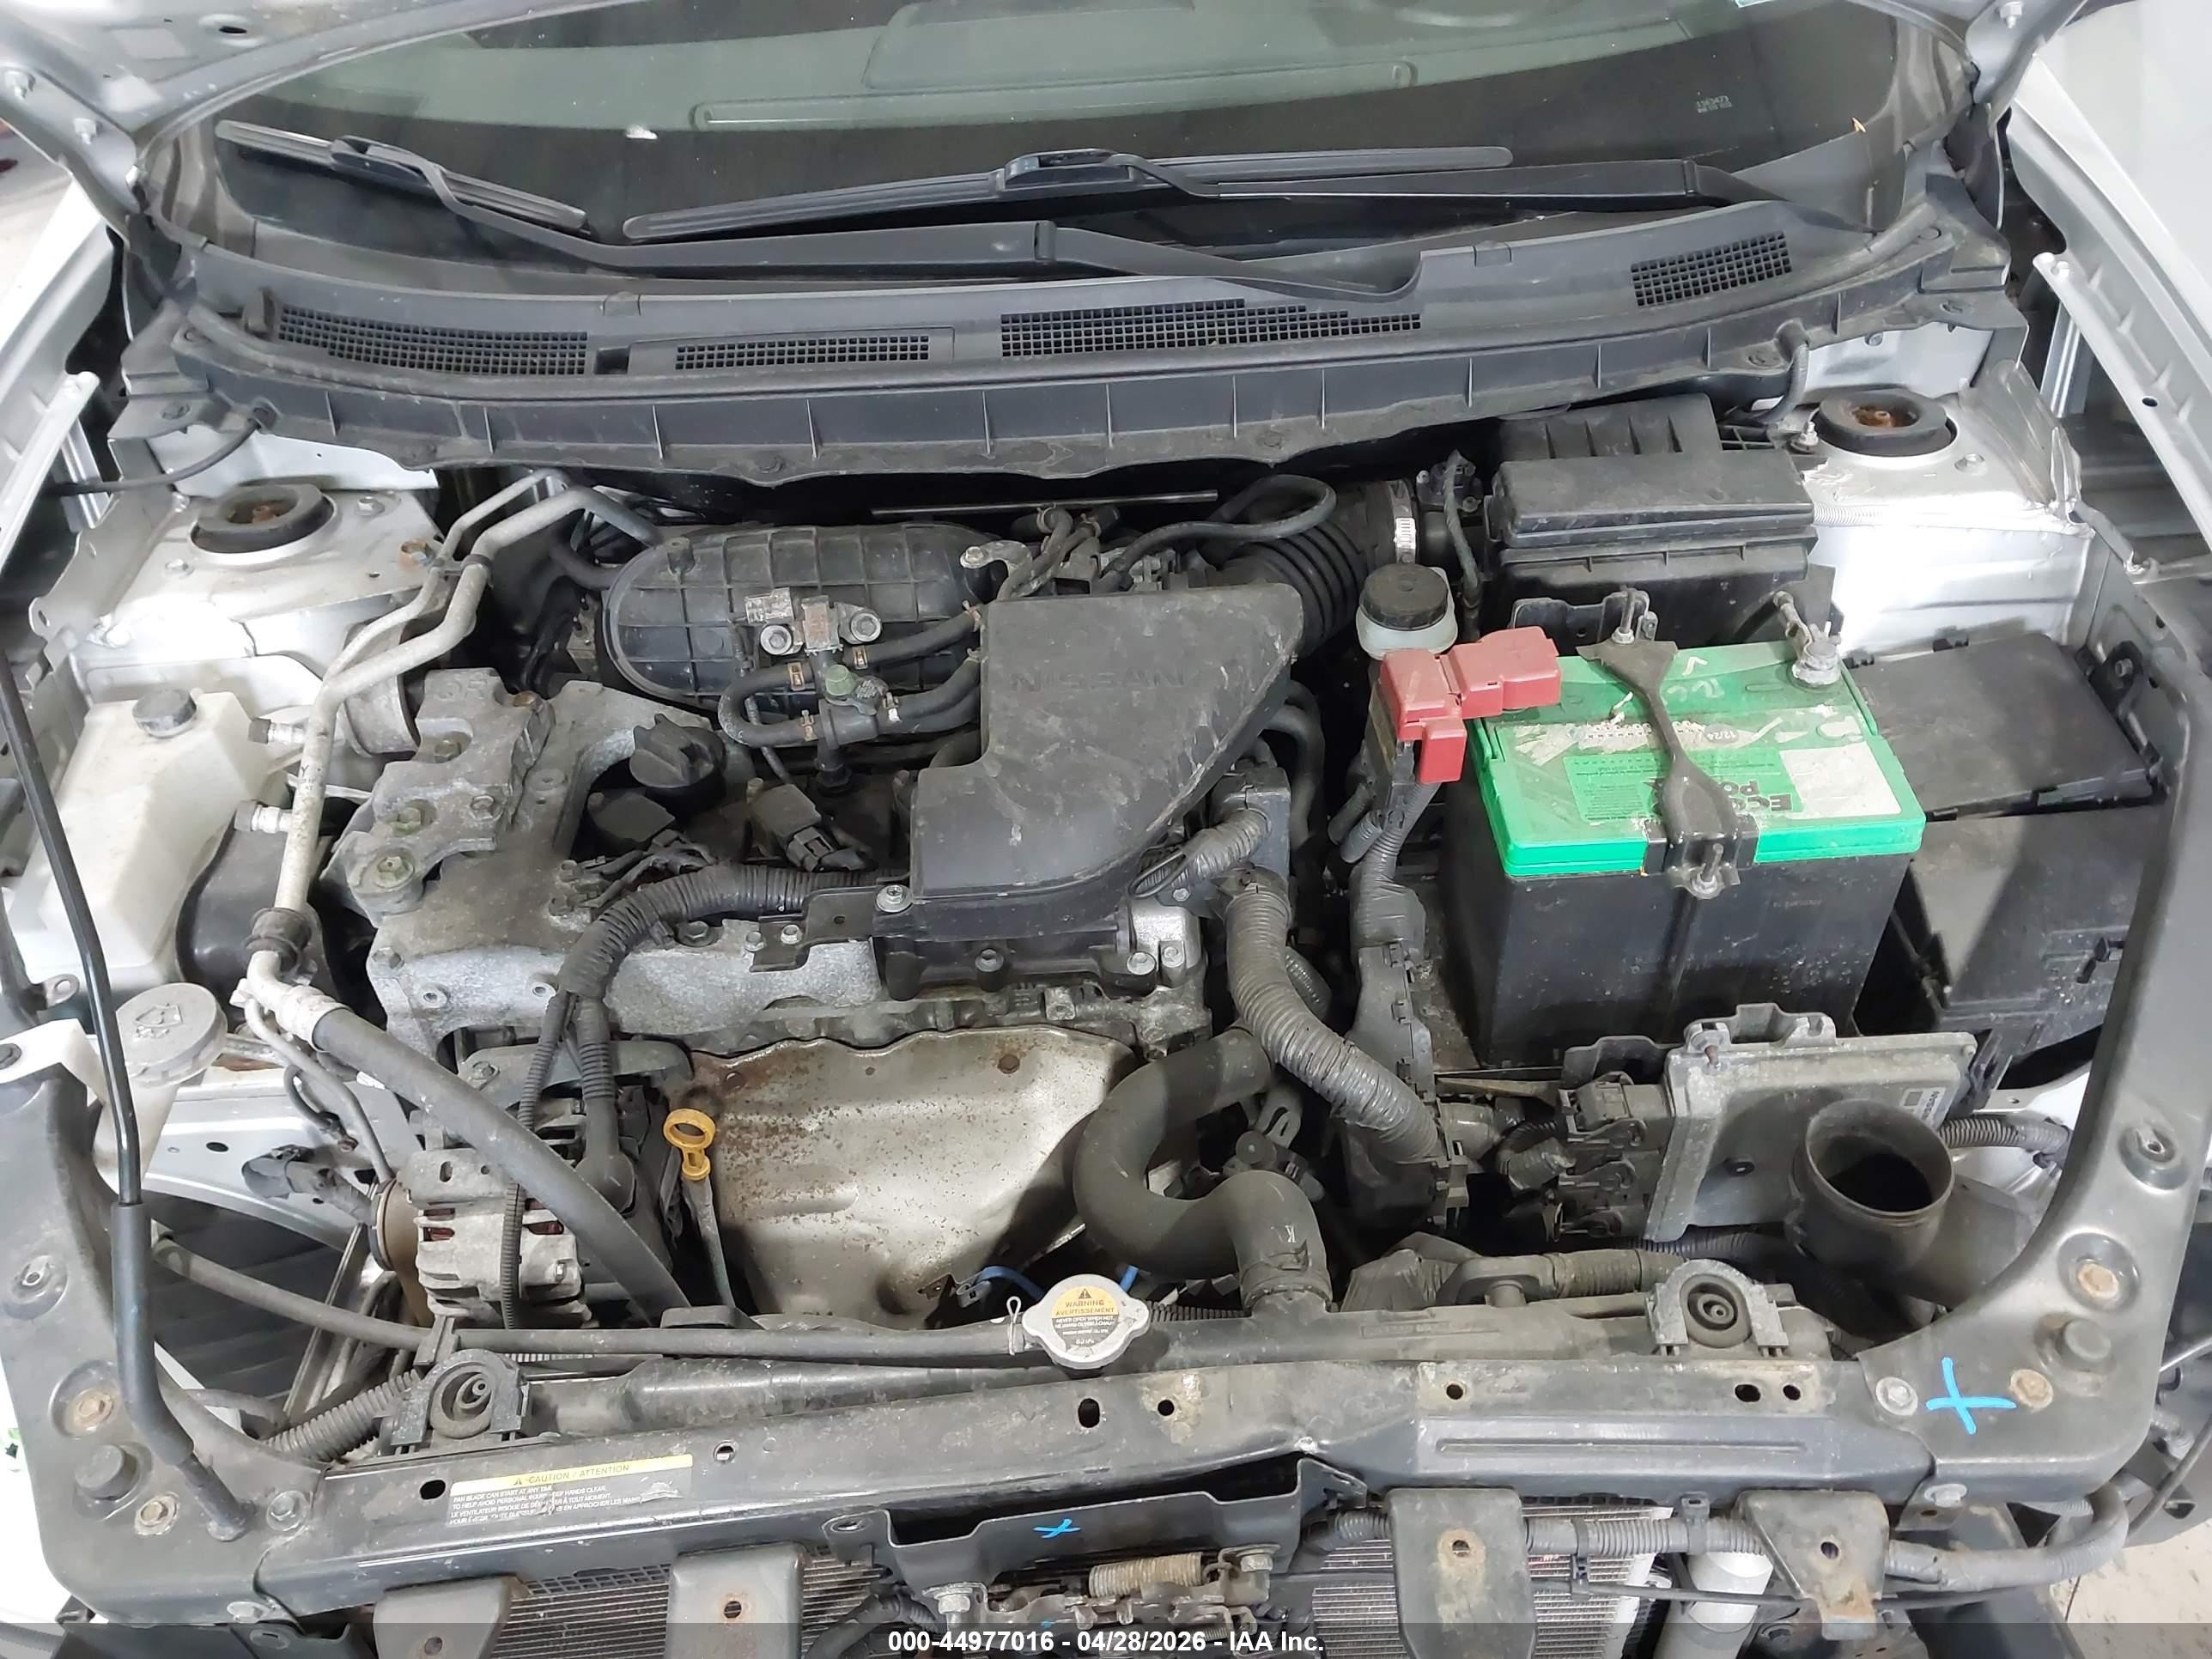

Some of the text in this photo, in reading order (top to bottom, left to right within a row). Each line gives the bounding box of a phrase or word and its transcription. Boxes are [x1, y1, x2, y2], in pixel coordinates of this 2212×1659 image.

[1066, 1299, 1104, 1308] WARNING
[1055, 1307, 1114, 1316] AVERTISSEMENT
[528, 1473, 569, 1484] CAUTION
[579, 1465, 629, 1477] ATTENTION
